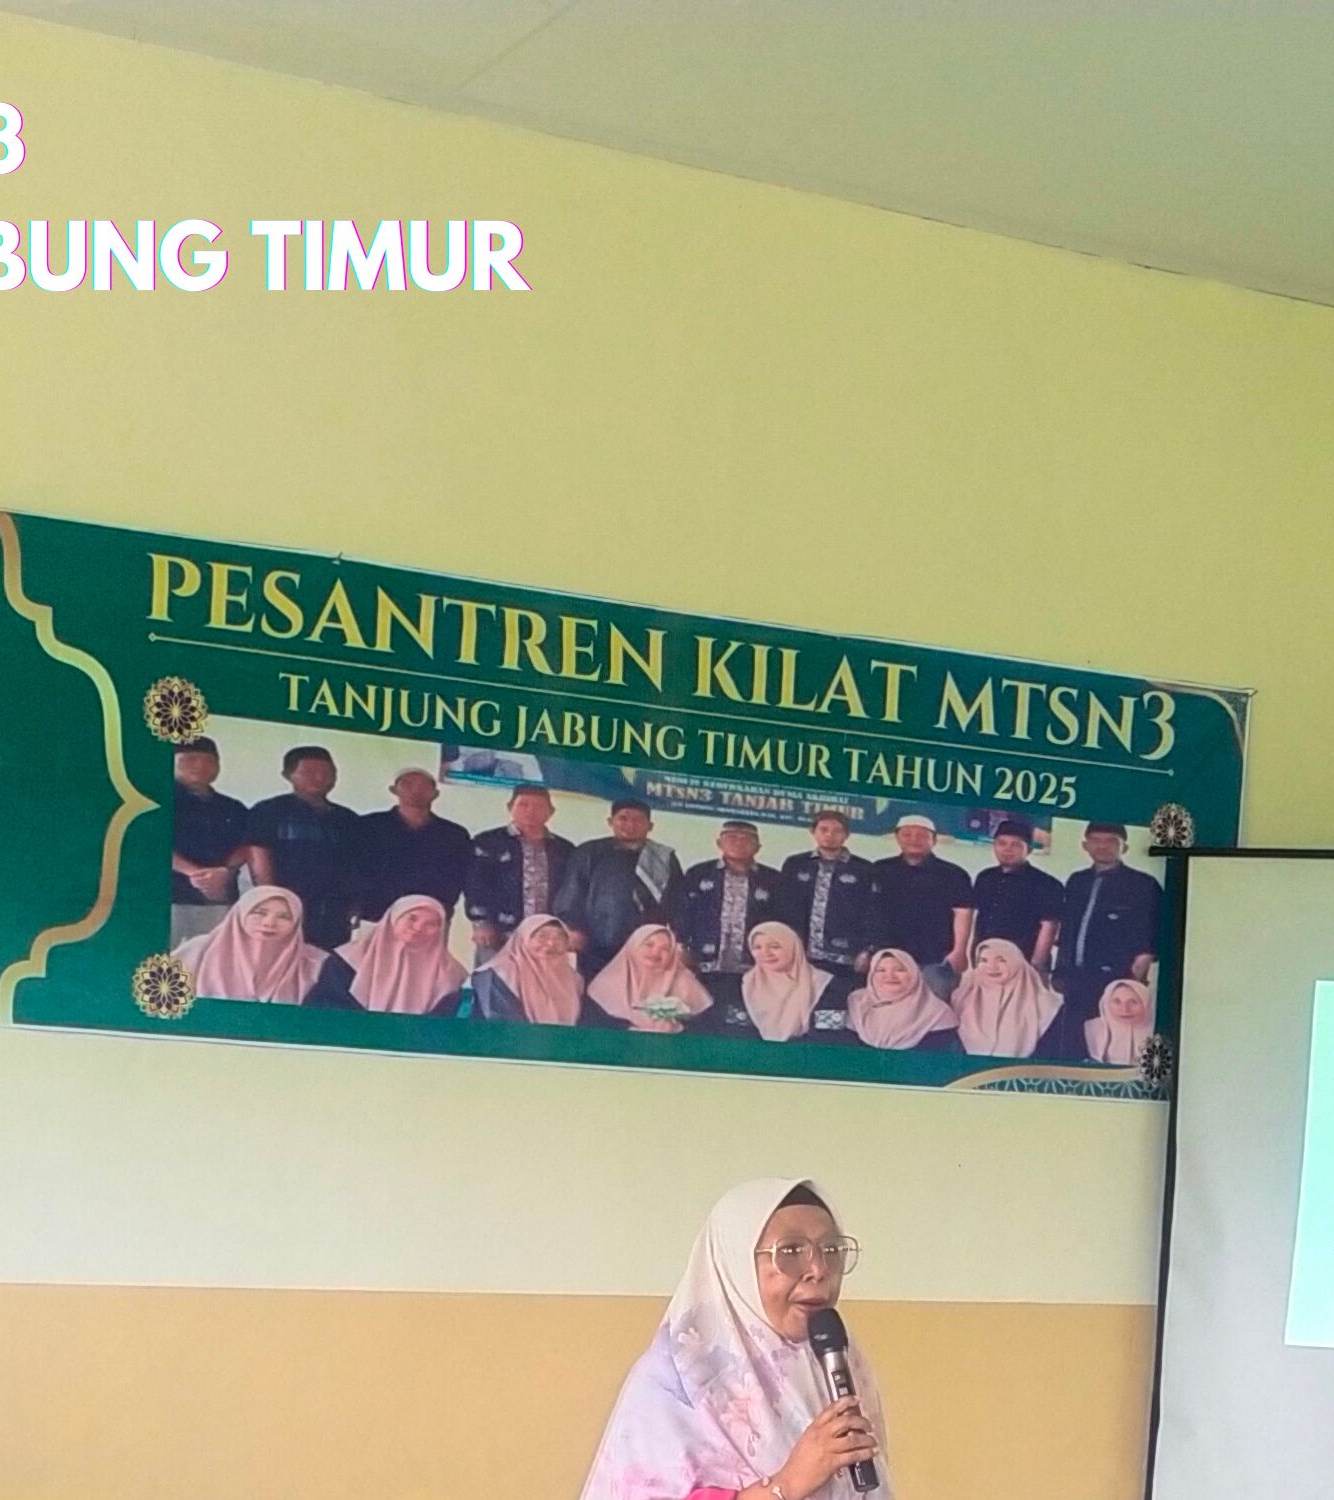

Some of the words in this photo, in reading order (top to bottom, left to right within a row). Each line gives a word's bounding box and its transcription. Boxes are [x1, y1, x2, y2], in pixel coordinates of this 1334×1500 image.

[145, 551, 667, 693] PESANTREN
[692, 635, 918, 724] KILAT
[933, 670, 1176, 761] MTSN3
[277, 671, 501, 737] TANJUNG
[514, 705, 687, 762] JABUNG
[697, 728, 832, 780] TIMUR
[842, 747, 984, 797] TAHUN
[994, 766, 1078, 809] 2025
